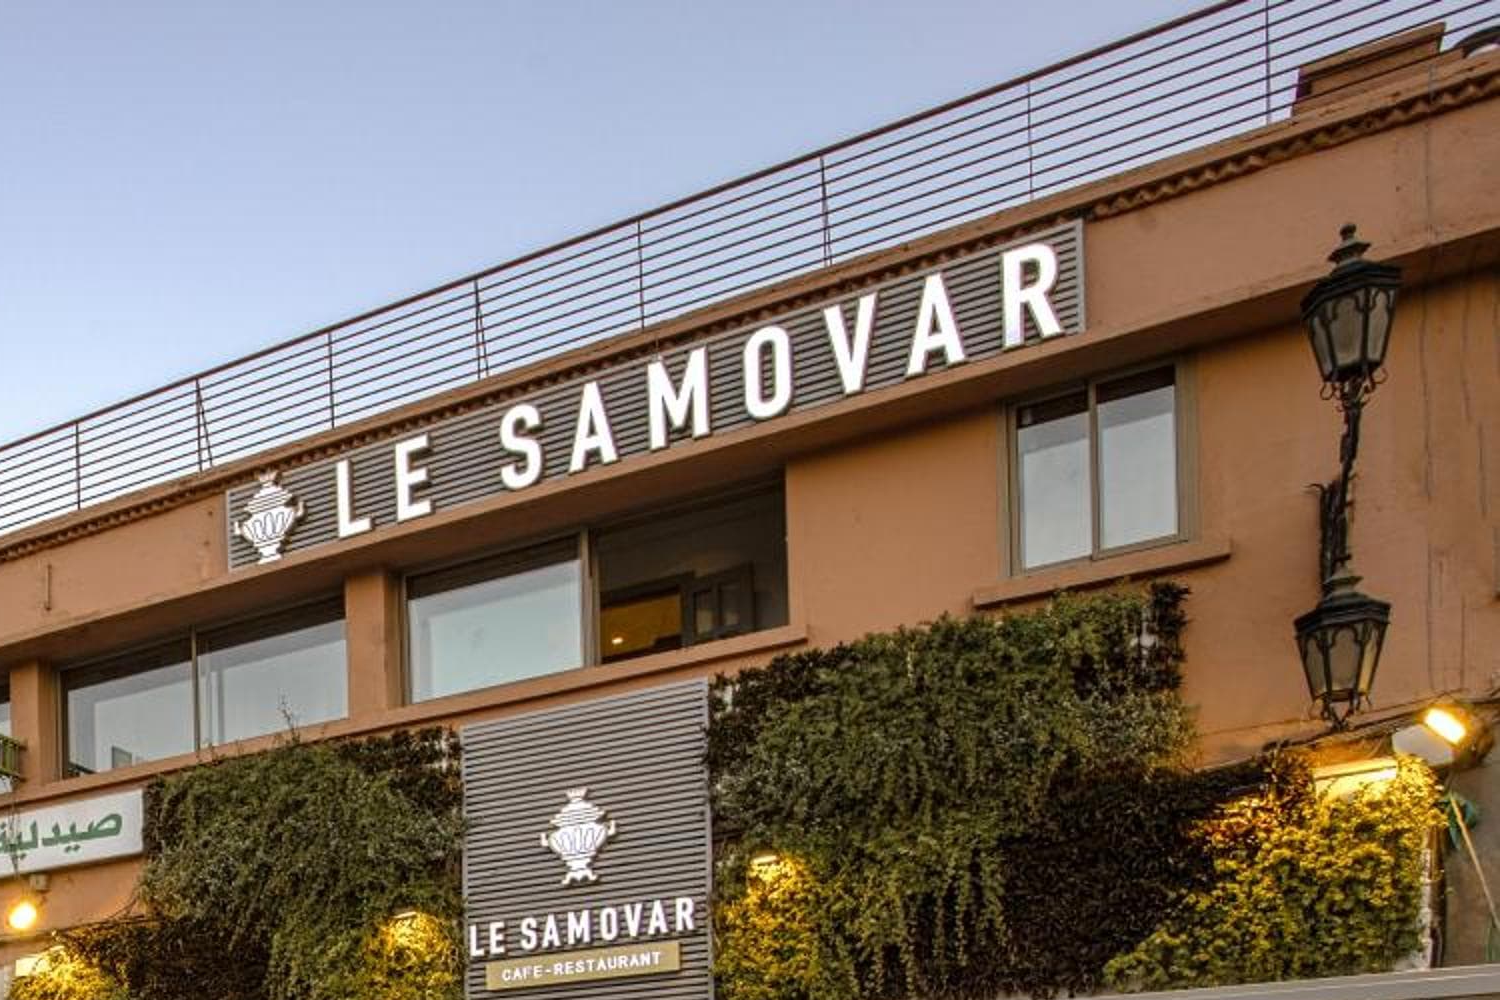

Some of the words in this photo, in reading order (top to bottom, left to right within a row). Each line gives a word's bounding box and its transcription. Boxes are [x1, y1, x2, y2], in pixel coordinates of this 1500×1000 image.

[335, 433, 433, 539] LE
[500, 242, 1064, 490] SAMOVAR
[469, 921, 506, 957] LE
[520, 897, 695, 950] SAMOVAR
[503, 951, 662, 982] CAFE-RESTAURANT
